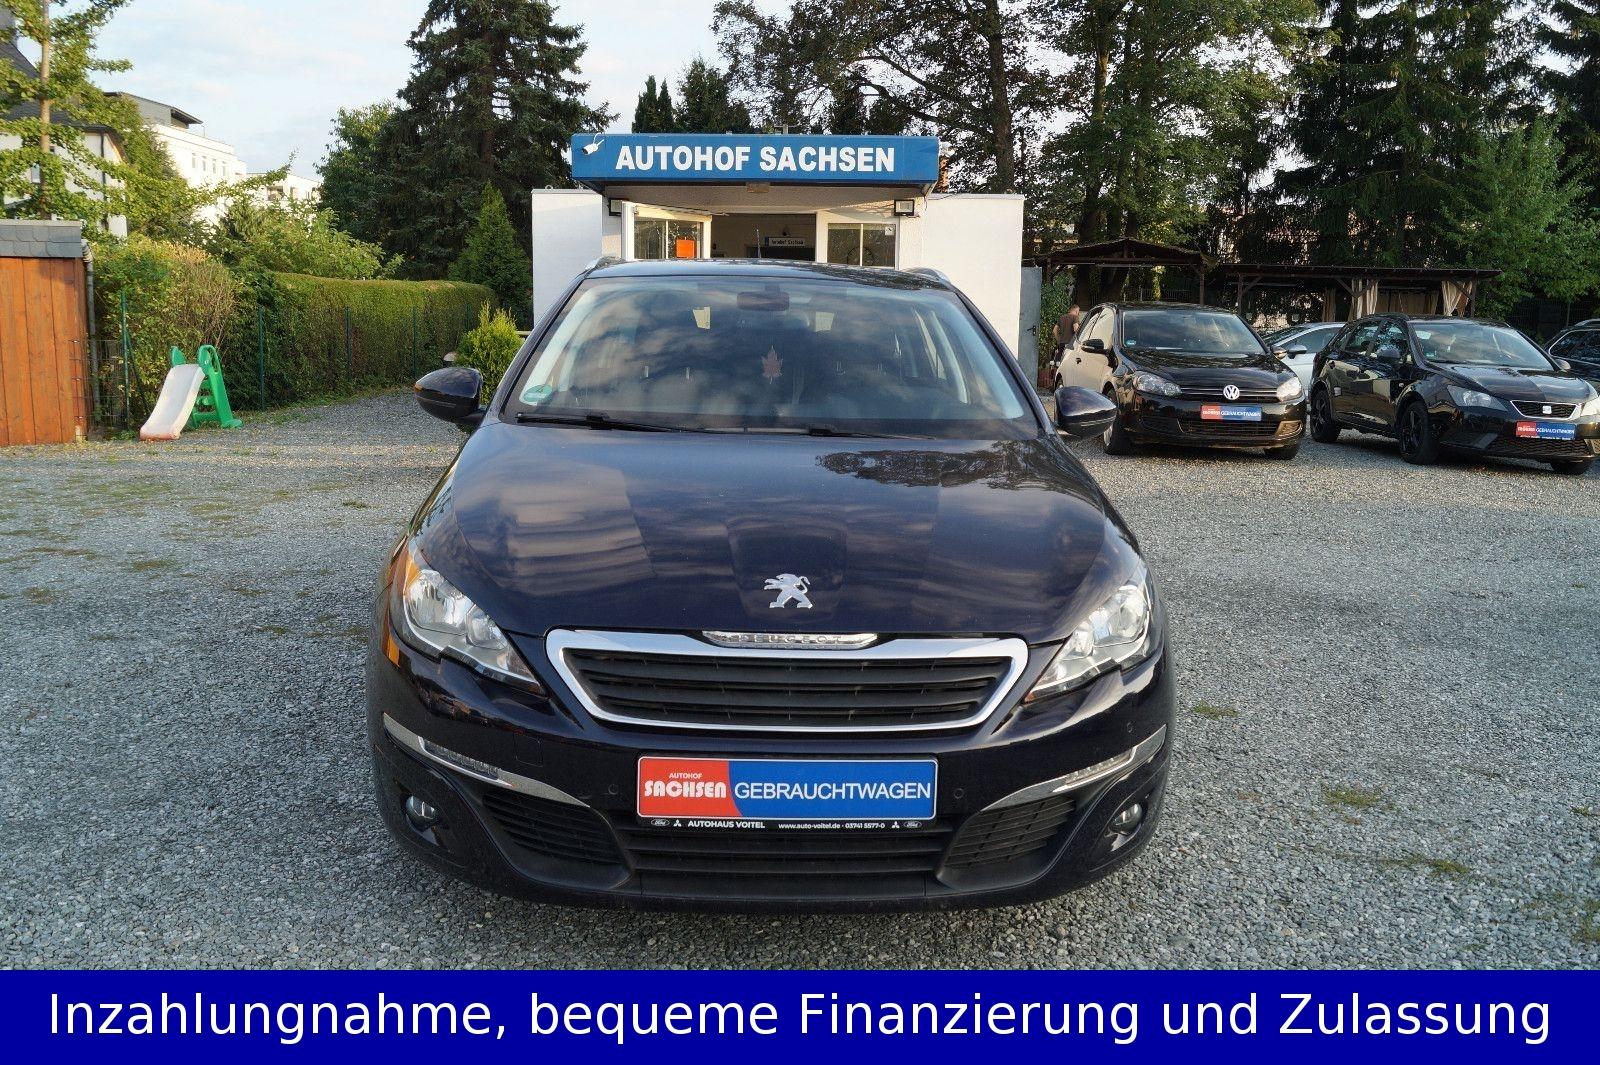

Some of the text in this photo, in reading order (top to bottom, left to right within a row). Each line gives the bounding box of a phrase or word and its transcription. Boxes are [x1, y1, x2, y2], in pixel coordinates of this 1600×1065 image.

[615, 145, 895, 172] AUTOHOF SACHSEN
[644, 780, 727, 798] SACHSEN
[734, 782, 931, 800] GEBRAUCHTWAGEN
[687, 820, 766, 829] AUTOHAUS VOITEL
